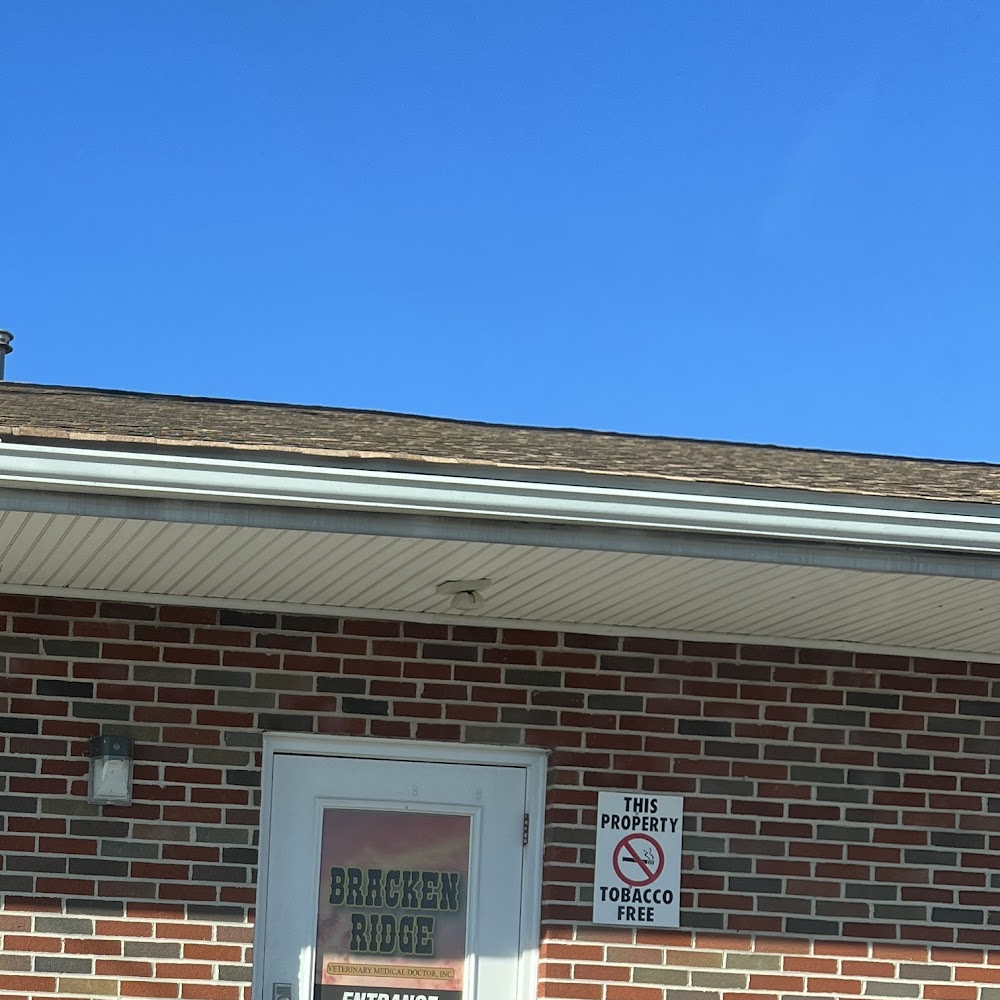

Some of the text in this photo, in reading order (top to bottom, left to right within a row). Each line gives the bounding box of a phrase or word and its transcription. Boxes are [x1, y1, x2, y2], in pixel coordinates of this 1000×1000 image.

[624, 797, 658, 814] THIS
[601, 814, 679, 833] PROPERTY
[329, 867, 461, 912] BRACKEN
[600, 886, 674, 905] TOBACCO
[617, 906, 655, 922] FREE
[350, 912, 435, 956] RIDGE
[328, 964, 454, 978] VETERINARY MEDICAL DOCTOR, INC.
